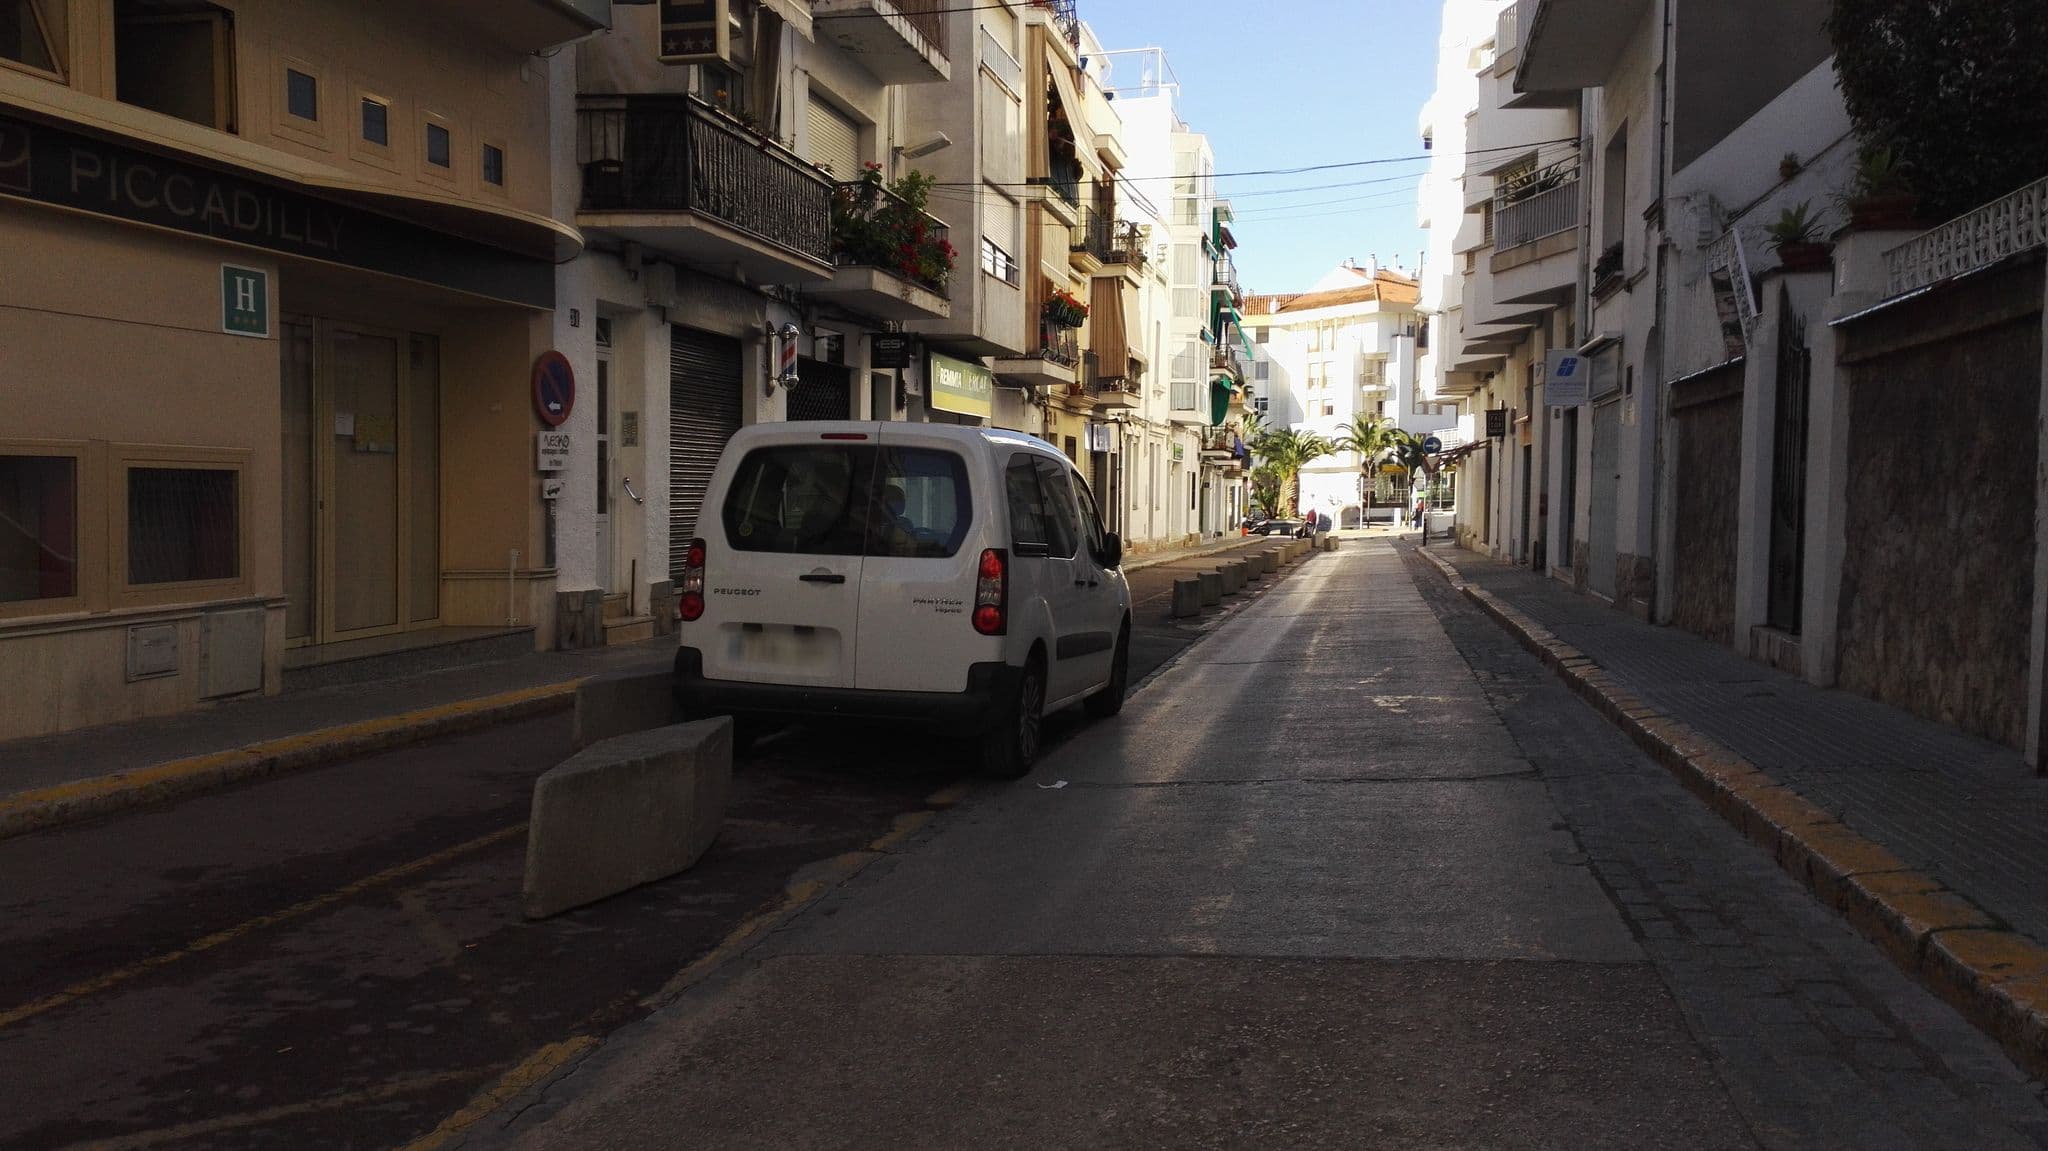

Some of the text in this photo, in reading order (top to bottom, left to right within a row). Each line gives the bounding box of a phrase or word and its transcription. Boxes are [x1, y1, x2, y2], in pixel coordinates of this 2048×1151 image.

[70, 147, 345, 251] PICCADILLY
[234, 276, 256, 313] H
[713, 587, 761, 596] PEUGEOT
